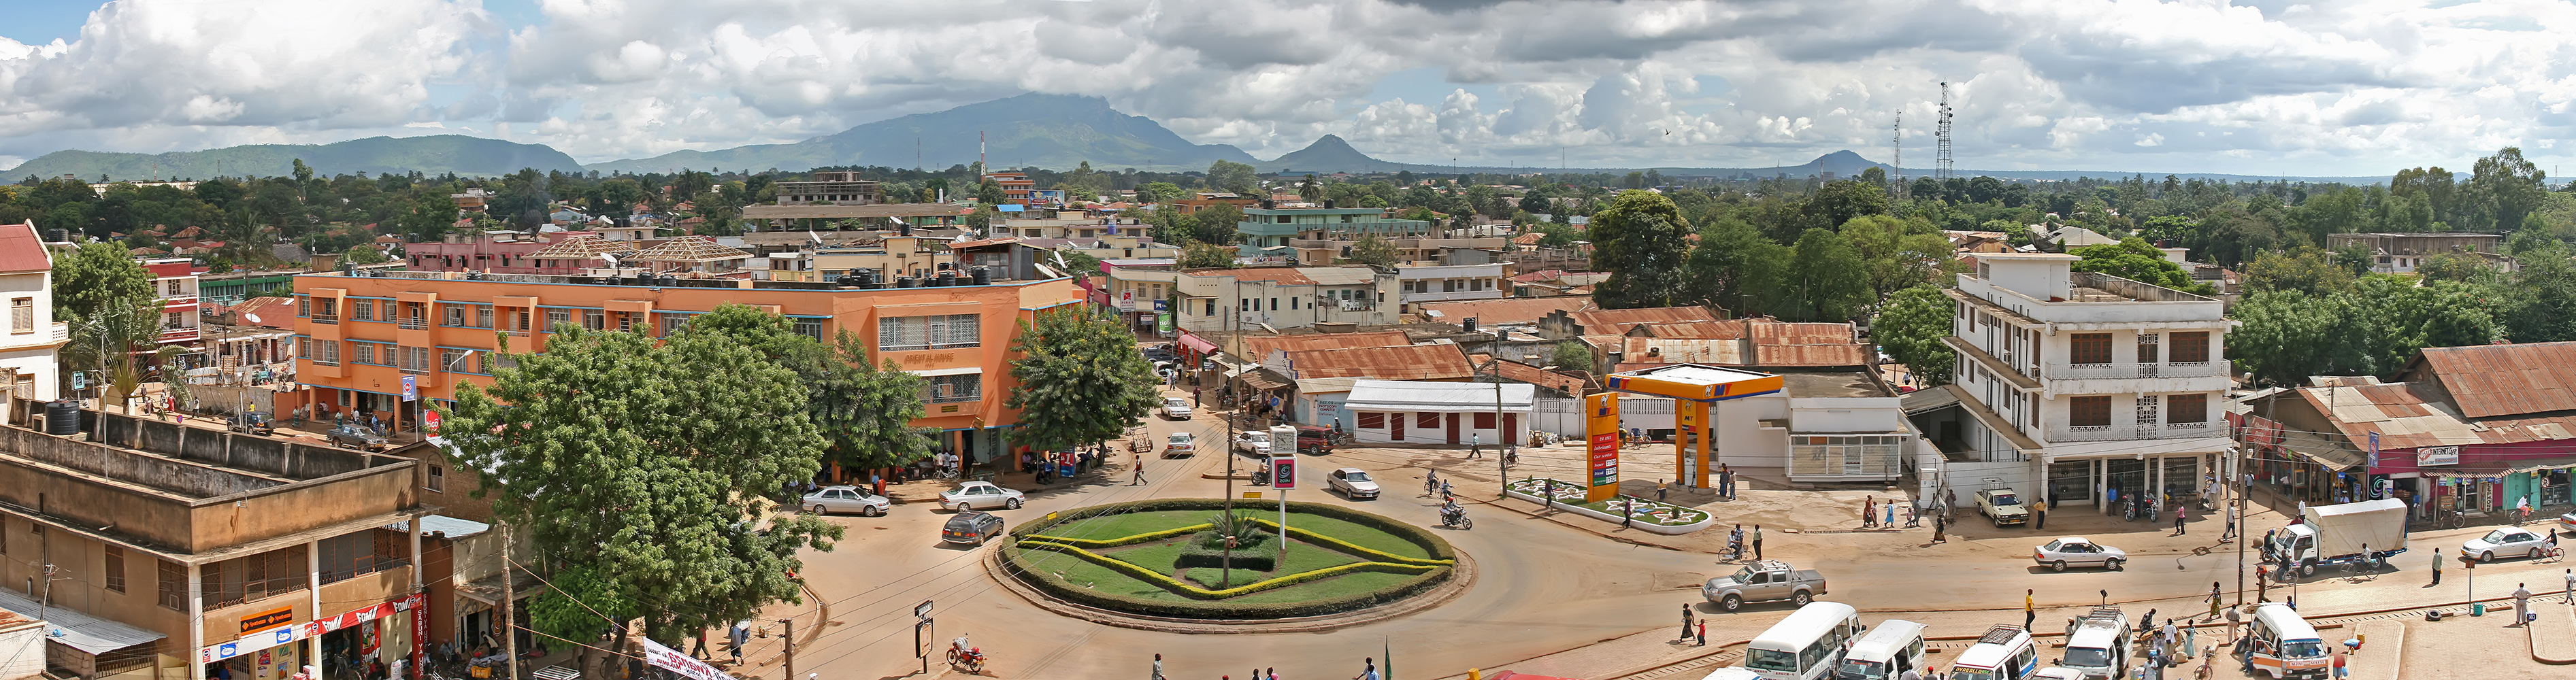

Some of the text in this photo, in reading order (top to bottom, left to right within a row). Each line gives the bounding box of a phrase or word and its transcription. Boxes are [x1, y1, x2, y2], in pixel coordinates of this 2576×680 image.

[1608, 376, 1631, 390] MT
[1714, 384, 1732, 396] MT
[1599, 407, 1611, 415] MT
[274, 613, 291, 621] Sportsman
[356, 605, 378, 624] FOMA
[249, 619, 266, 627] Sportsman
[322, 613, 345, 632] FOMA
[424, 619, 428, 629] YA
[418, 643, 423, 654] YA
